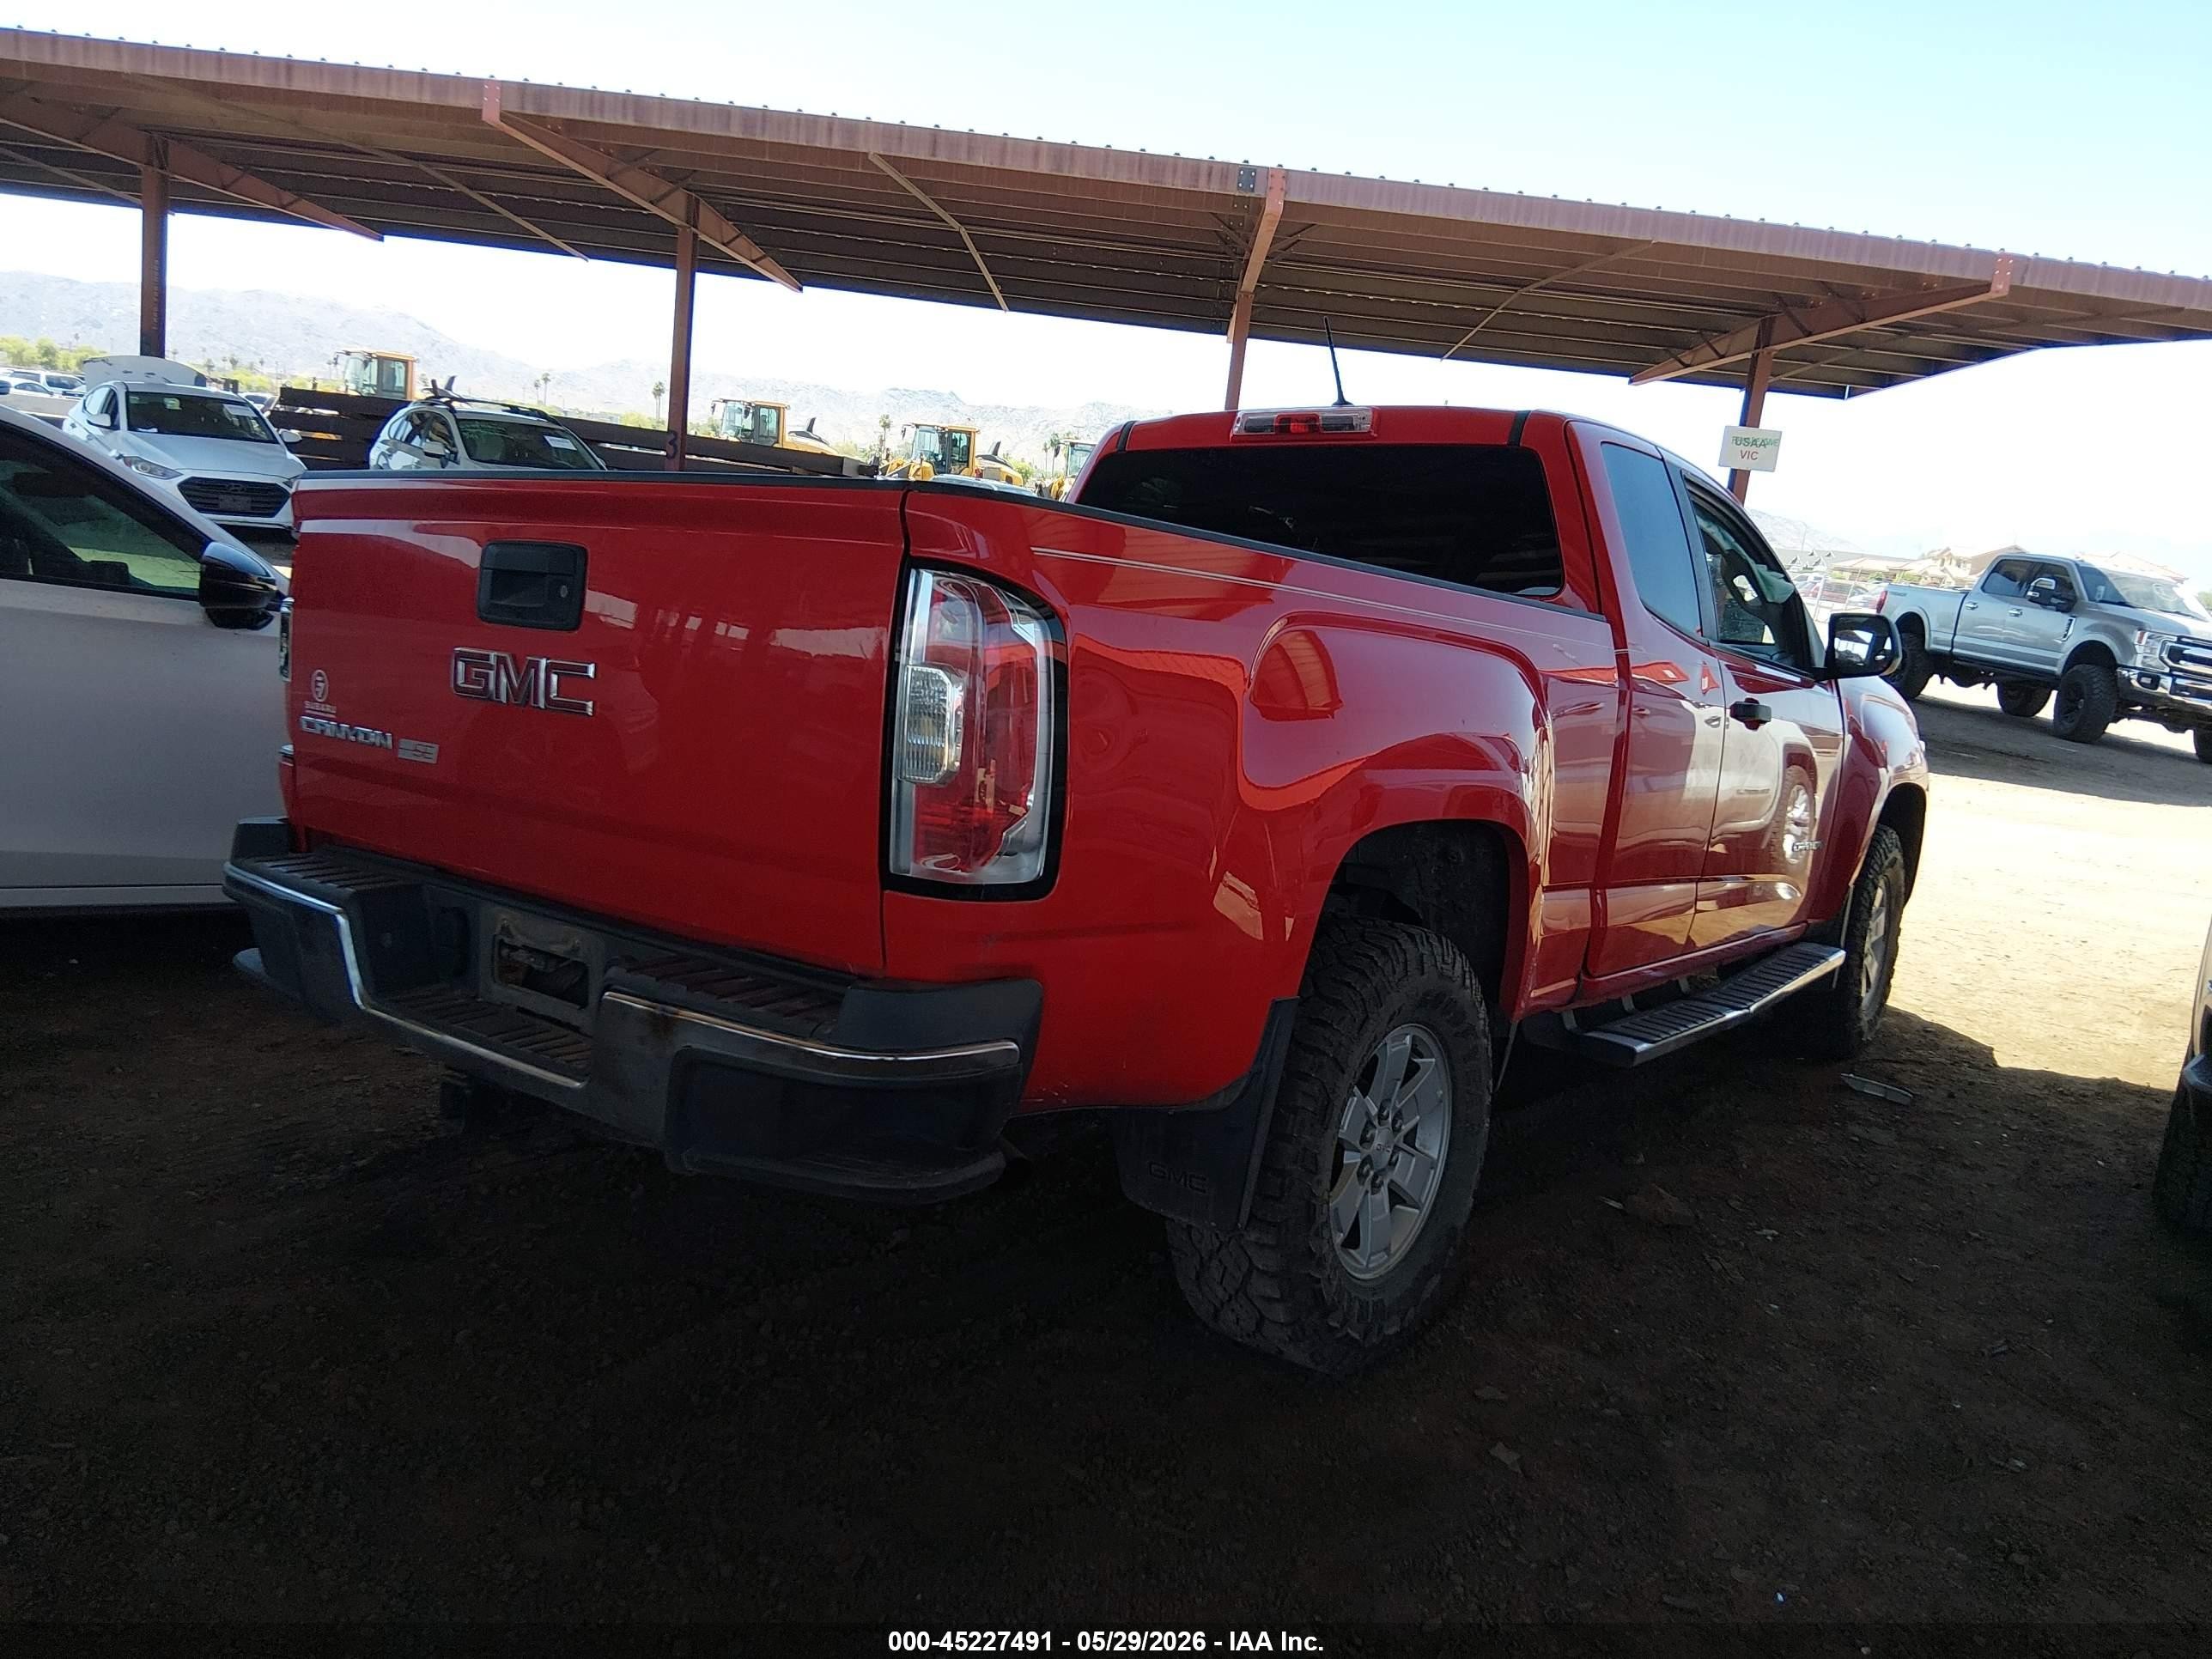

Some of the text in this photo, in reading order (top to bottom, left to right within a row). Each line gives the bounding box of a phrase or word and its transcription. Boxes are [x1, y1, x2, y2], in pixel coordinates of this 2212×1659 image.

[1735, 436, 1766, 449] USAA
[1740, 449, 1759, 461] VIC
[453, 647, 596, 717] GMC
[301, 715, 393, 750] CANYON
[1148, 1161, 1207, 1194] GMC
